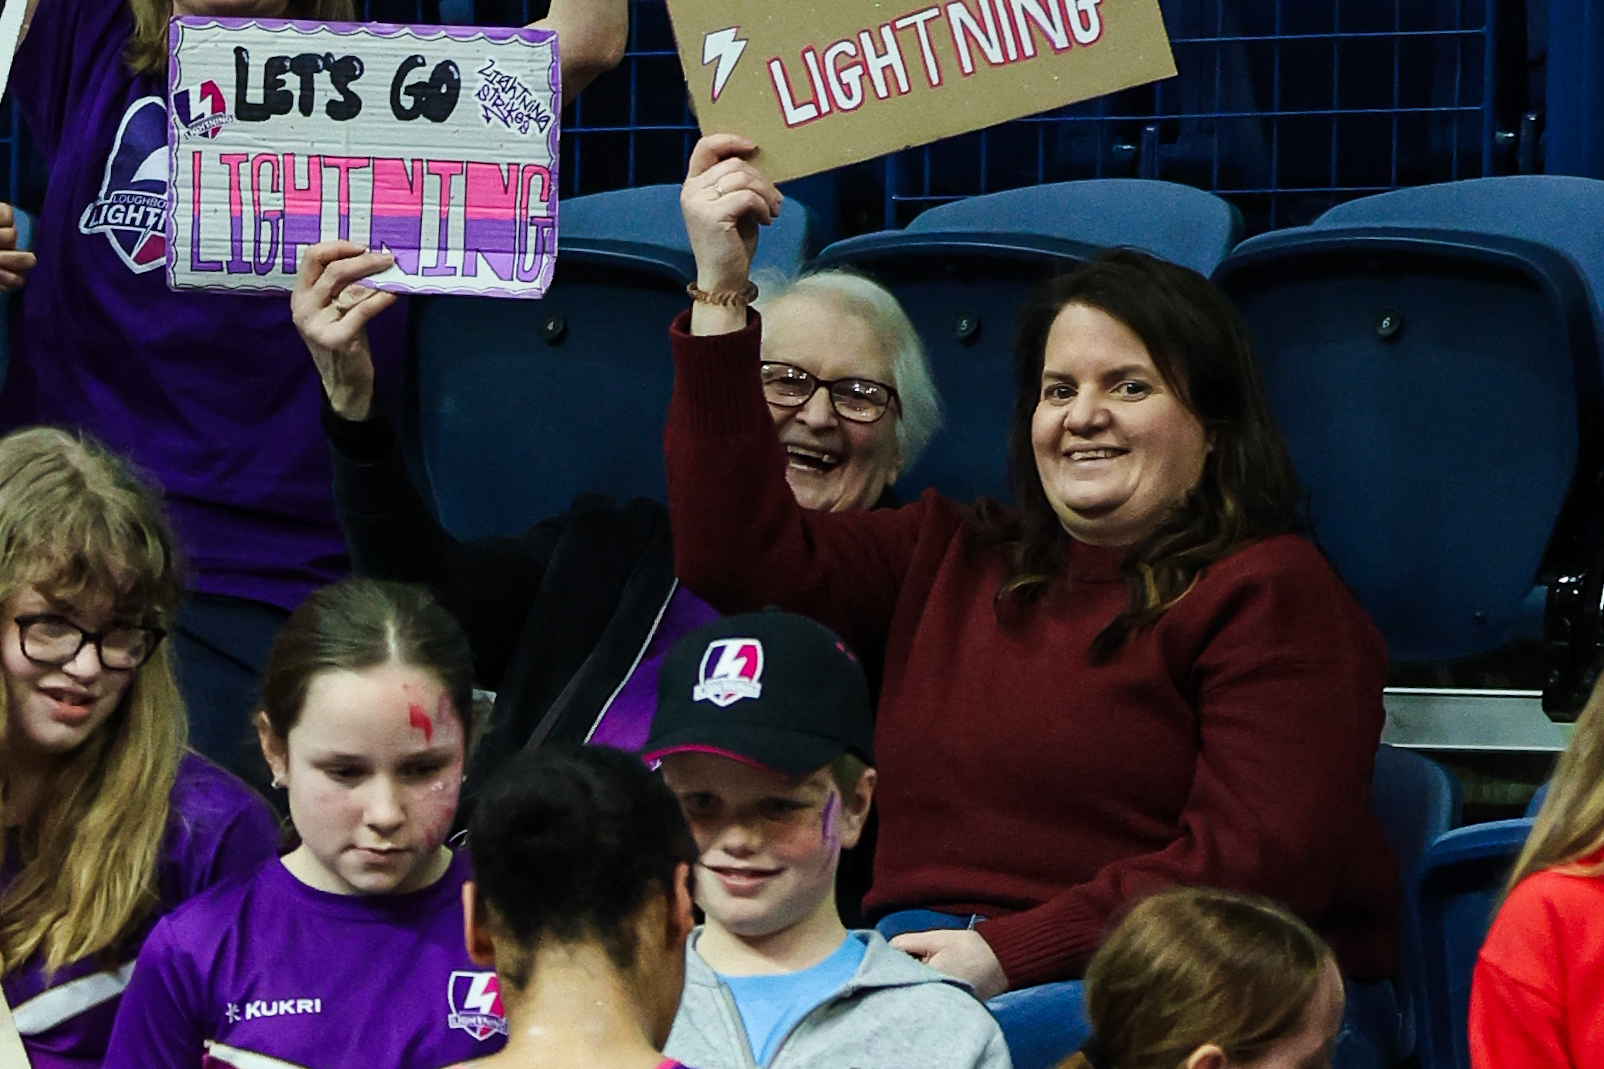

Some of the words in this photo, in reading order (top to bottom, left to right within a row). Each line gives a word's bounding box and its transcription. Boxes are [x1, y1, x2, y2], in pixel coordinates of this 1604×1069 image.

[233, 46, 365, 122] LET'S
[390, 54, 462, 123] GO
[191, 150, 554, 283] LIGHTNING
[959, 318, 969, 331] 5
[1381, 316, 1391, 329] 6
[245, 998, 322, 1021] KUKRI
